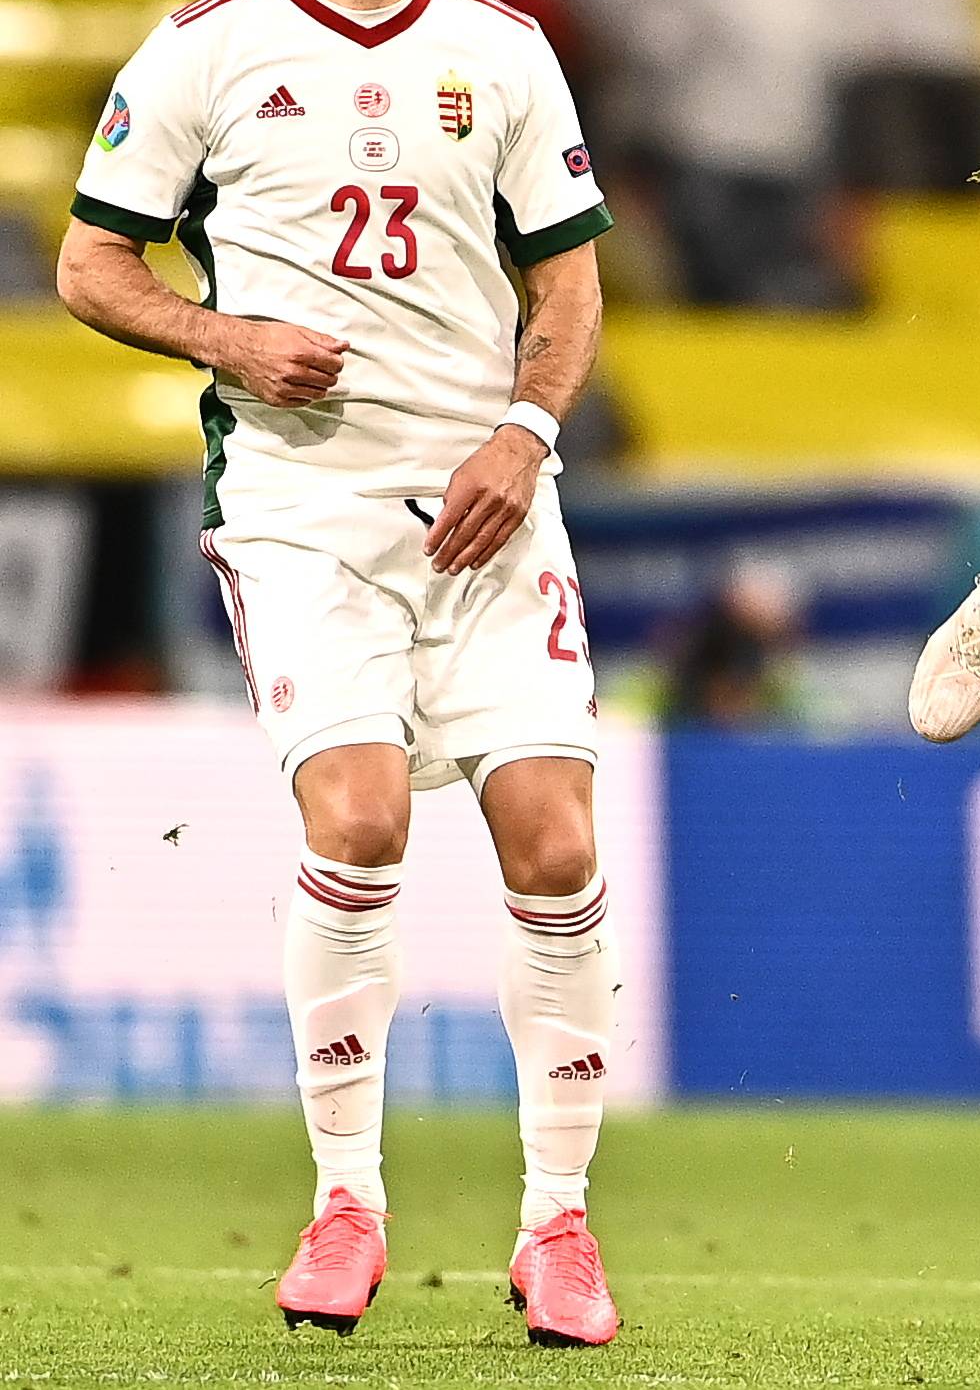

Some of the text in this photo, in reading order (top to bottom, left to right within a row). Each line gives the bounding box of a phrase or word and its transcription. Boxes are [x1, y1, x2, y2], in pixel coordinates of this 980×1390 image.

[256, 106, 306, 119] adidas
[330, 184, 419, 280] 23
[310, 1051, 371, 1066] adidas
